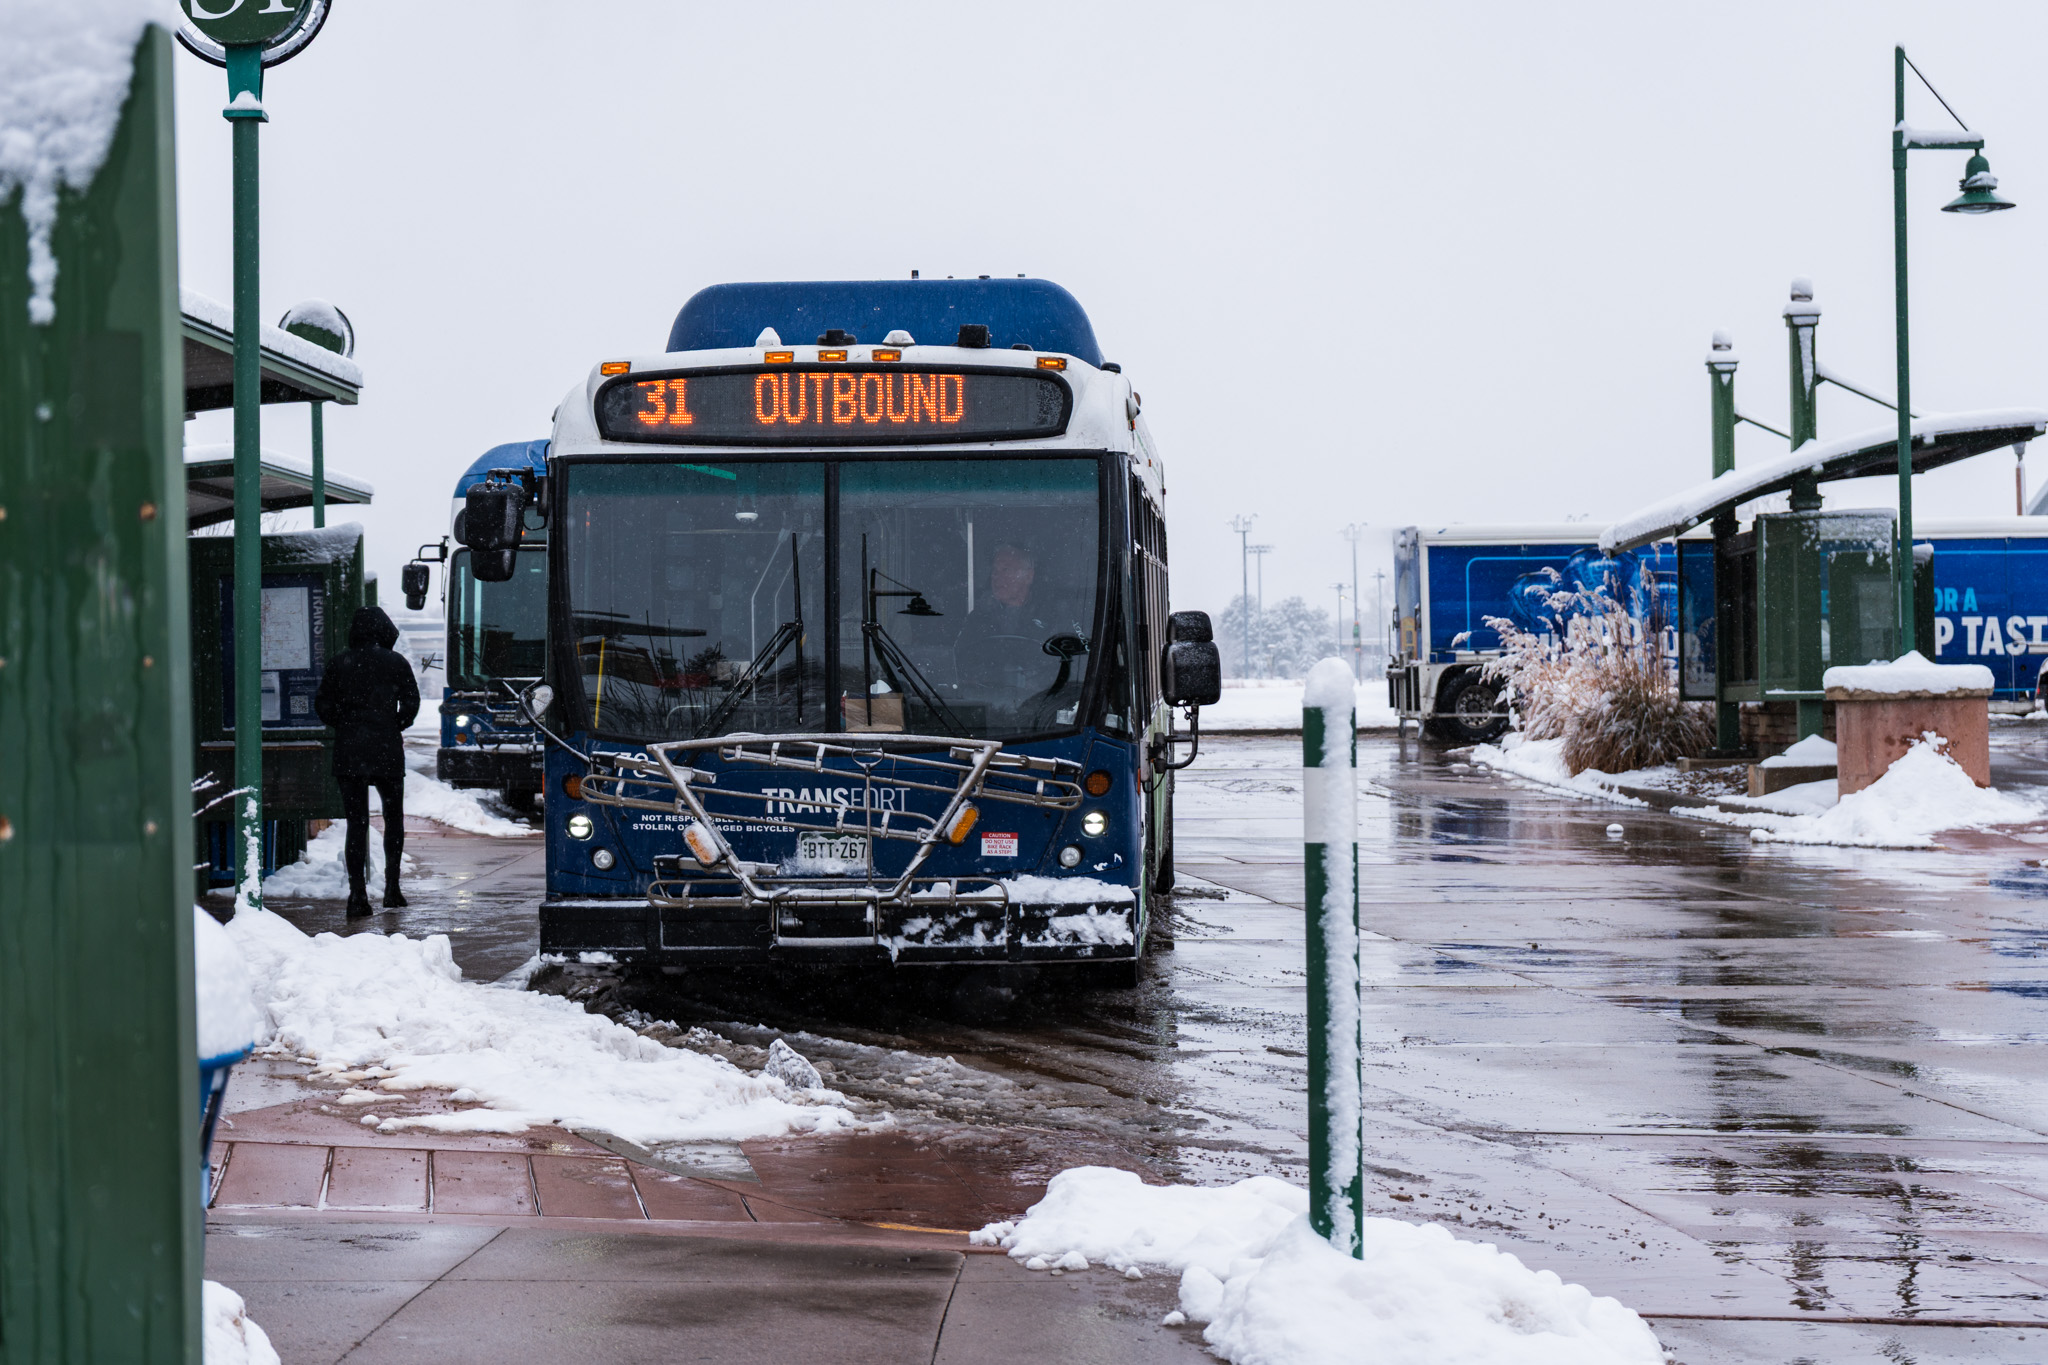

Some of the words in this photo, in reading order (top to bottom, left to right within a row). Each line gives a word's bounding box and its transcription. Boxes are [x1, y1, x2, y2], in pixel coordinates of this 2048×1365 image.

[637, 379, 693, 425] 31
[755, 372, 965, 425] OUTBOUND
[1934, 586, 1959, 612] OR
[1962, 586, 1978, 612] A
[1961, 614, 2048, 656] TAST
[761, 787, 911, 814] TRANSFORT
[632, 823, 675, 832] STOLEN,
[746, 824, 796, 833] BICYCLES
[641, 814, 663, 822] NOT
[665, 814, 735, 823] RESPOBLE
